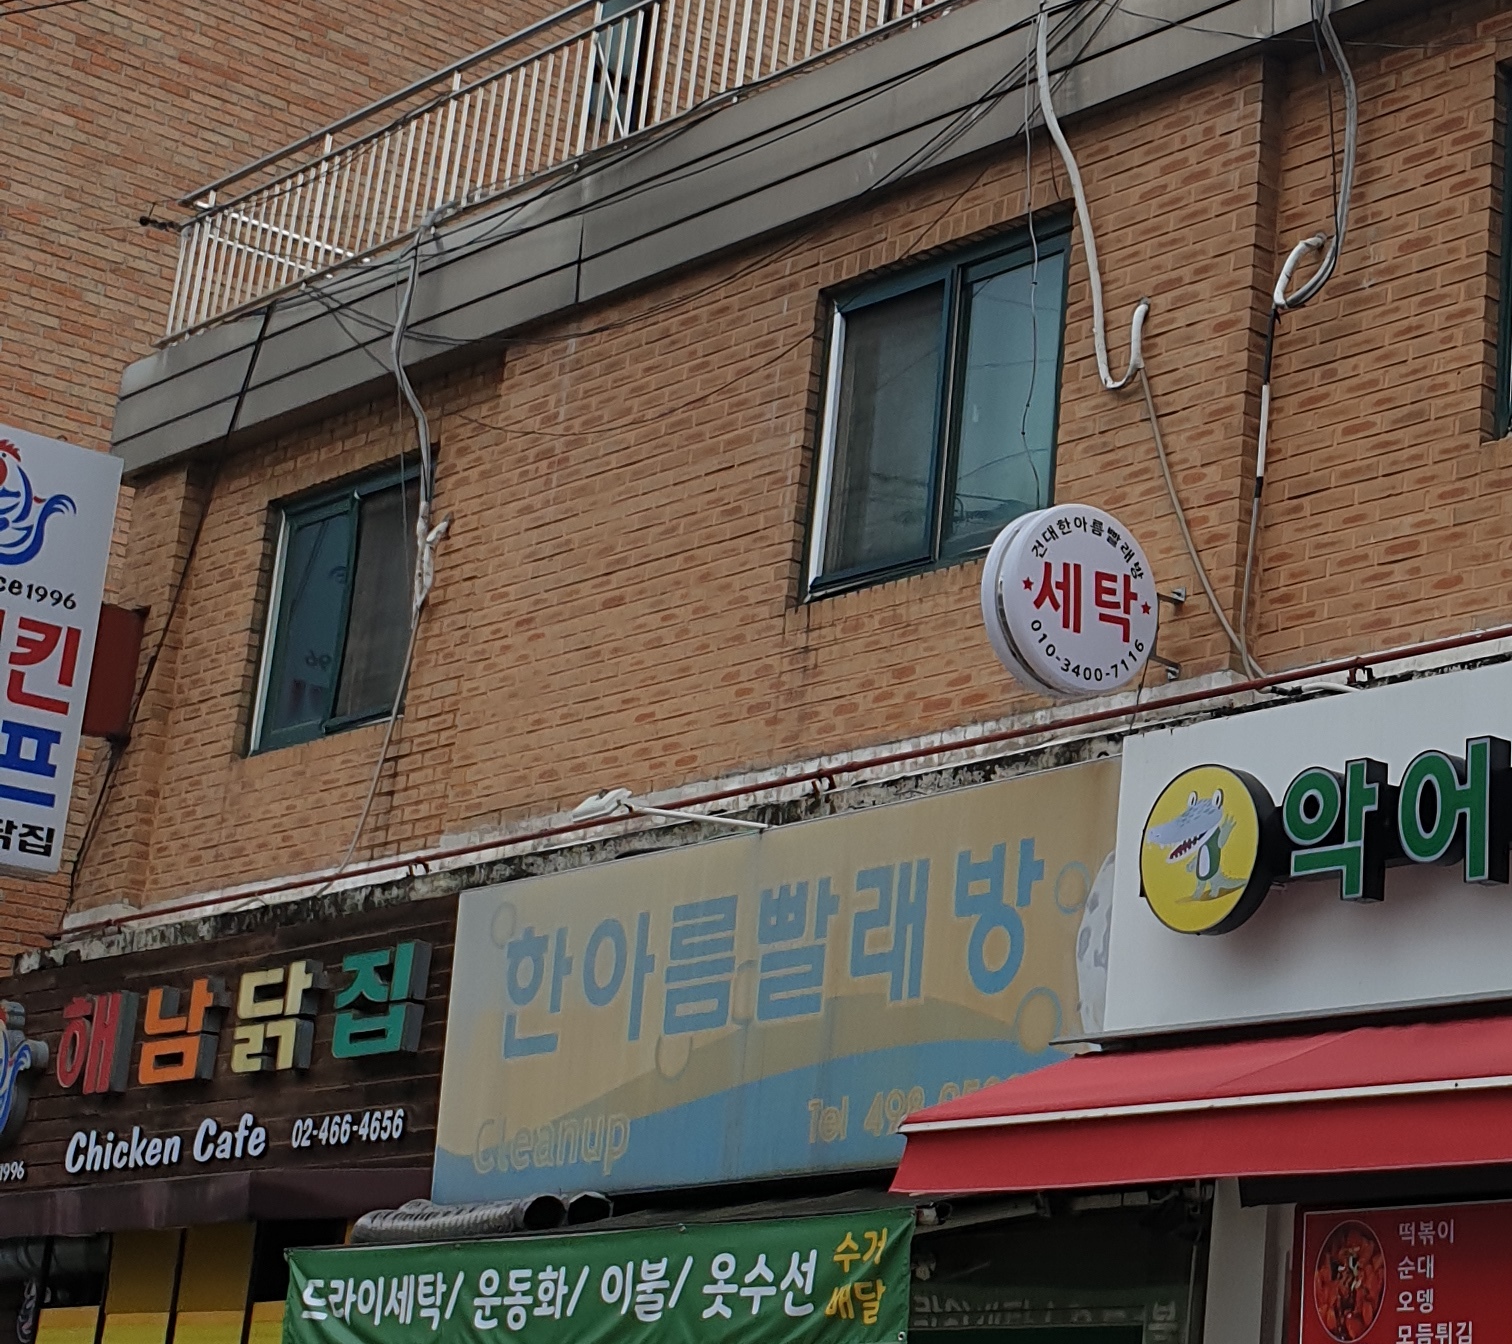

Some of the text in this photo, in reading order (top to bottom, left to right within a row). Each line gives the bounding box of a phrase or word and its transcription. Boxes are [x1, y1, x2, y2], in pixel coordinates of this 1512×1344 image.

[1032, 561, 1138, 643] 세탁
[1031, 619, 1145, 682] 010-3400-7116
[1282, 736, 1498, 902] 악어
[502, 837, 1046, 1060] 한아름빨래방
[56, 939, 430, 1096] 해남닭집
[64, 1108, 404, 1175] Chicken Cafe 02-466-4656
[473, 1113, 631, 1177] Cleanup
[807, 1094, 850, 1144] Tel
[833, 1227, 888, 1273] 수거
[1399, 1218, 1456, 1246] 떡볶이
[701, 1249, 818, 1320] 옷수선
[1397, 1254, 1436, 1280] 순대
[1396, 1288, 1435, 1314] 오뎅
